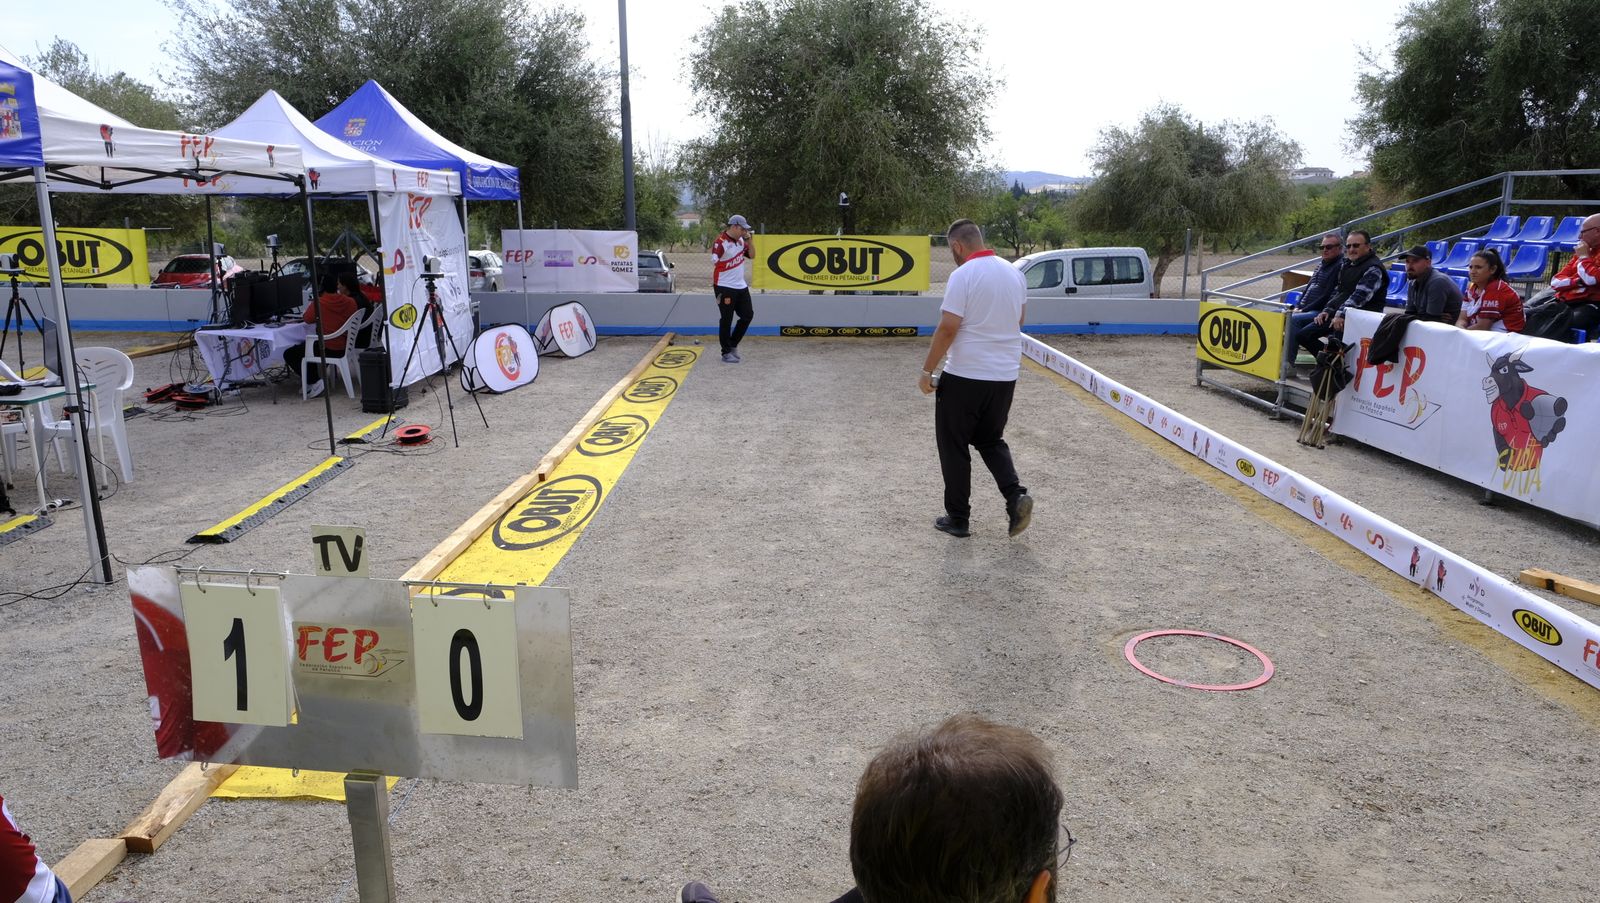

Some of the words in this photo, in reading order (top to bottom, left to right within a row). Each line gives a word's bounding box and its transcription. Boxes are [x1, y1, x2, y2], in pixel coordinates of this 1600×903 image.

[505, 249, 534, 263] FEP
[798, 246, 884, 275] OBUT
[1210, 315, 1251, 355] OBUT
[585, 421, 637, 446] OBUT
[1263, 468, 1280, 487] FEP
[507, 489, 587, 532] OBUT
[312, 534, 362, 572] TV
[296, 626, 380, 665] FEP
[1522, 613, 1552, 640] OBUT
[223, 617, 248, 711] 1
[449, 628, 484, 722] 0
